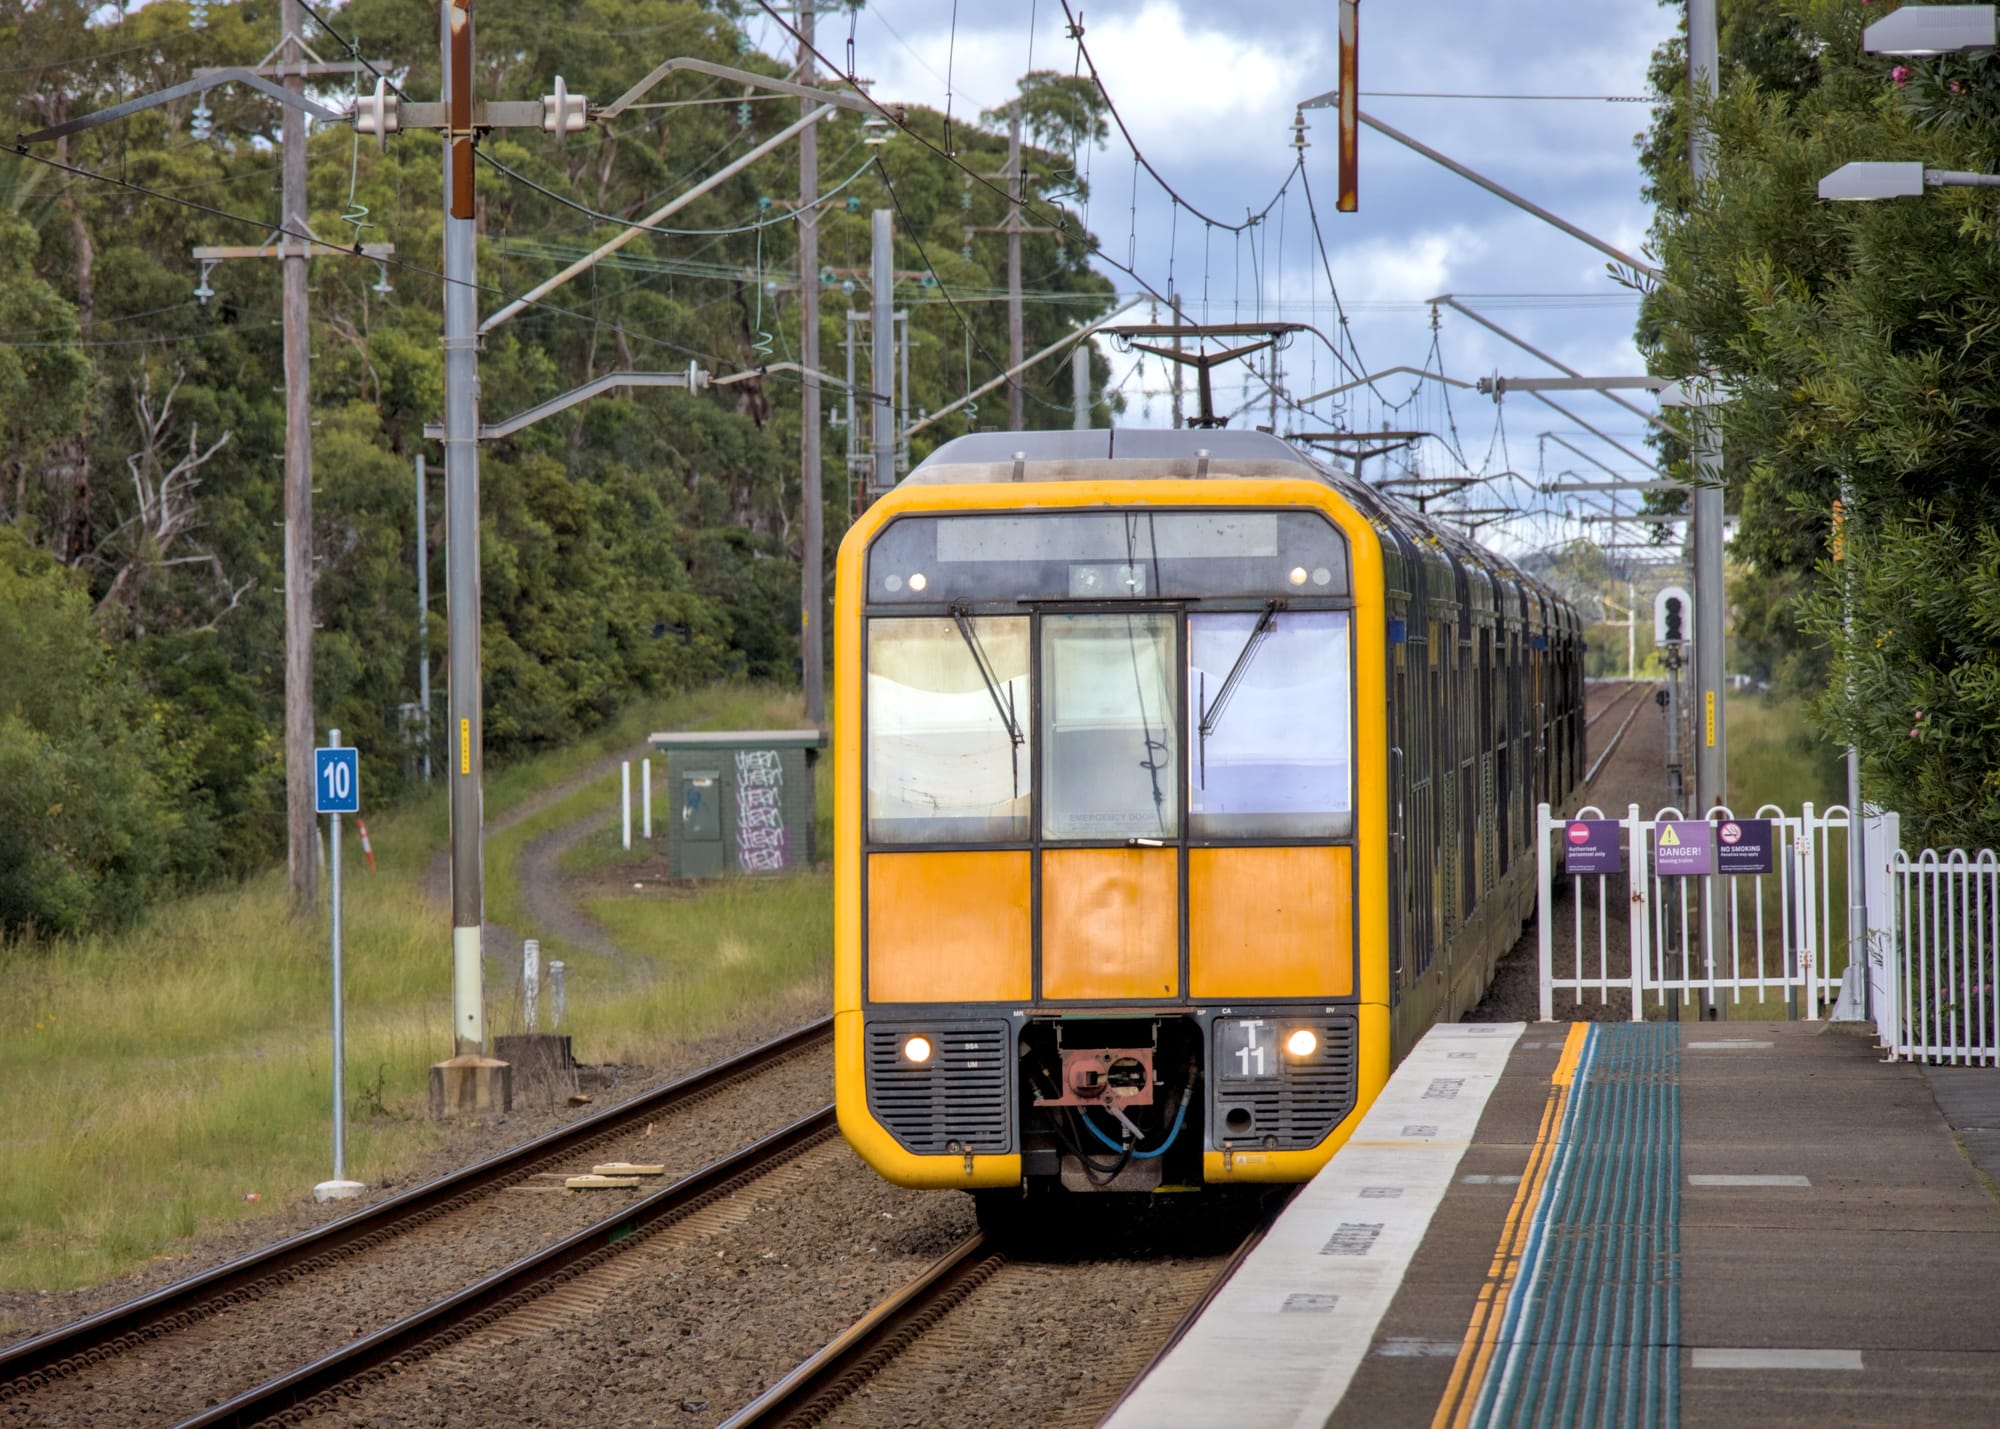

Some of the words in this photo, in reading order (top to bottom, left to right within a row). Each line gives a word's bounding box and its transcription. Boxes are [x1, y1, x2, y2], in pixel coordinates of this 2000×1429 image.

[323, 761, 350, 799] 10
[1659, 847, 1701, 857] DANGER!
[1240, 1020, 1264, 1049] T
[1235, 1046, 1264, 1075] 11
